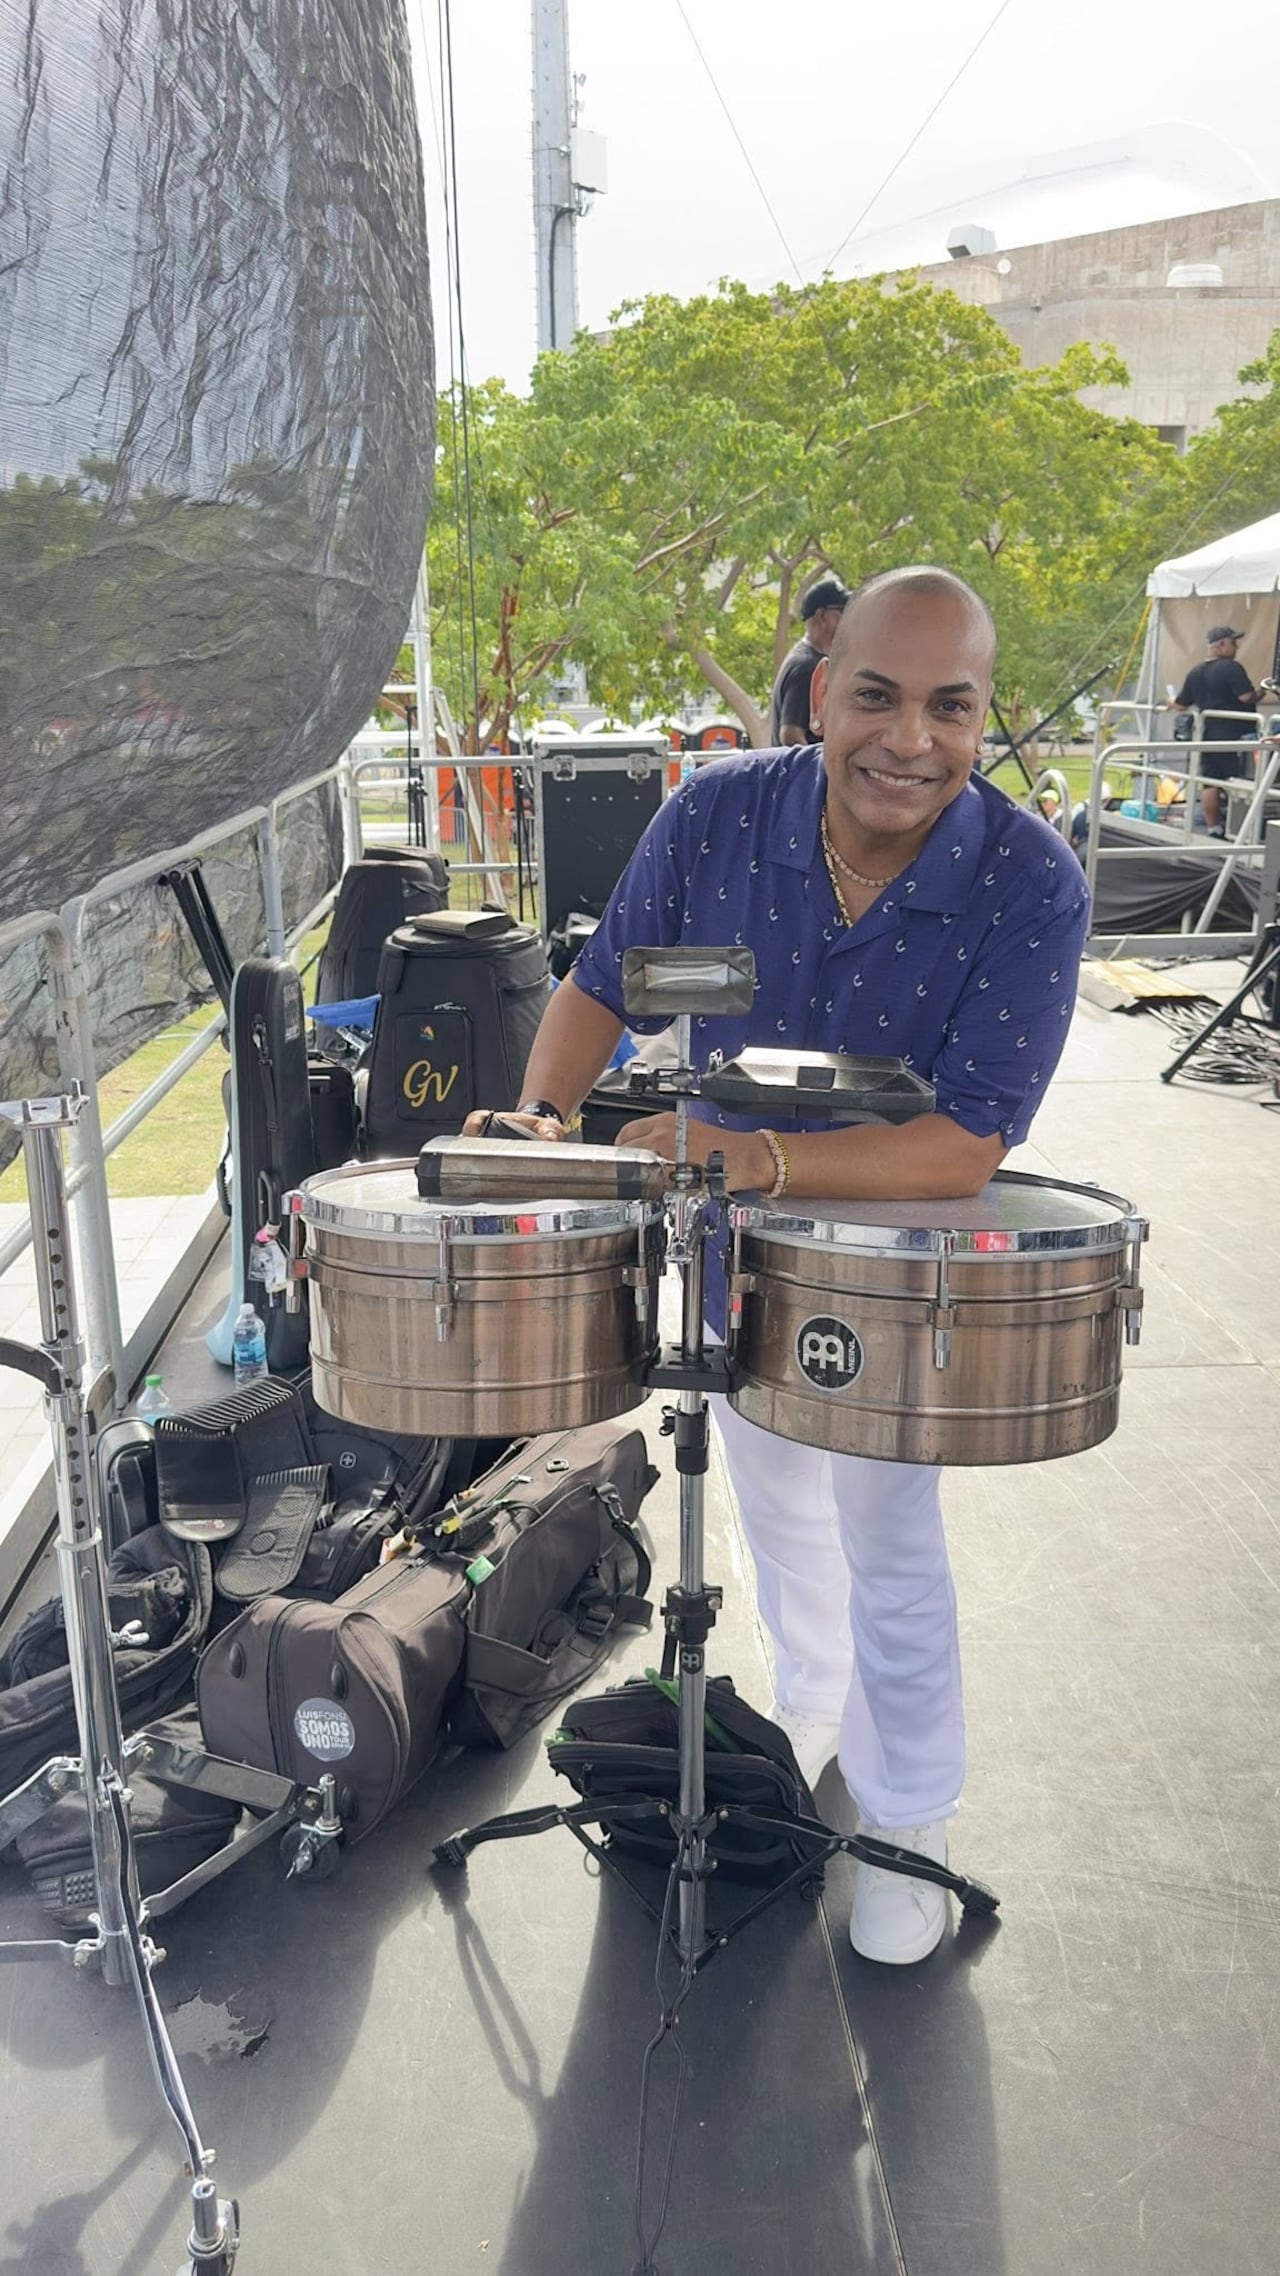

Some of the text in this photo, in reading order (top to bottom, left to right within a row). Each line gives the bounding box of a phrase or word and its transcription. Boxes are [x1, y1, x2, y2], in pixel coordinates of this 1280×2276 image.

[848, 1337, 856, 1374] MEINL
[299, 1719, 350, 1737] SOMOS
[302, 1733, 331, 1749] UNO
